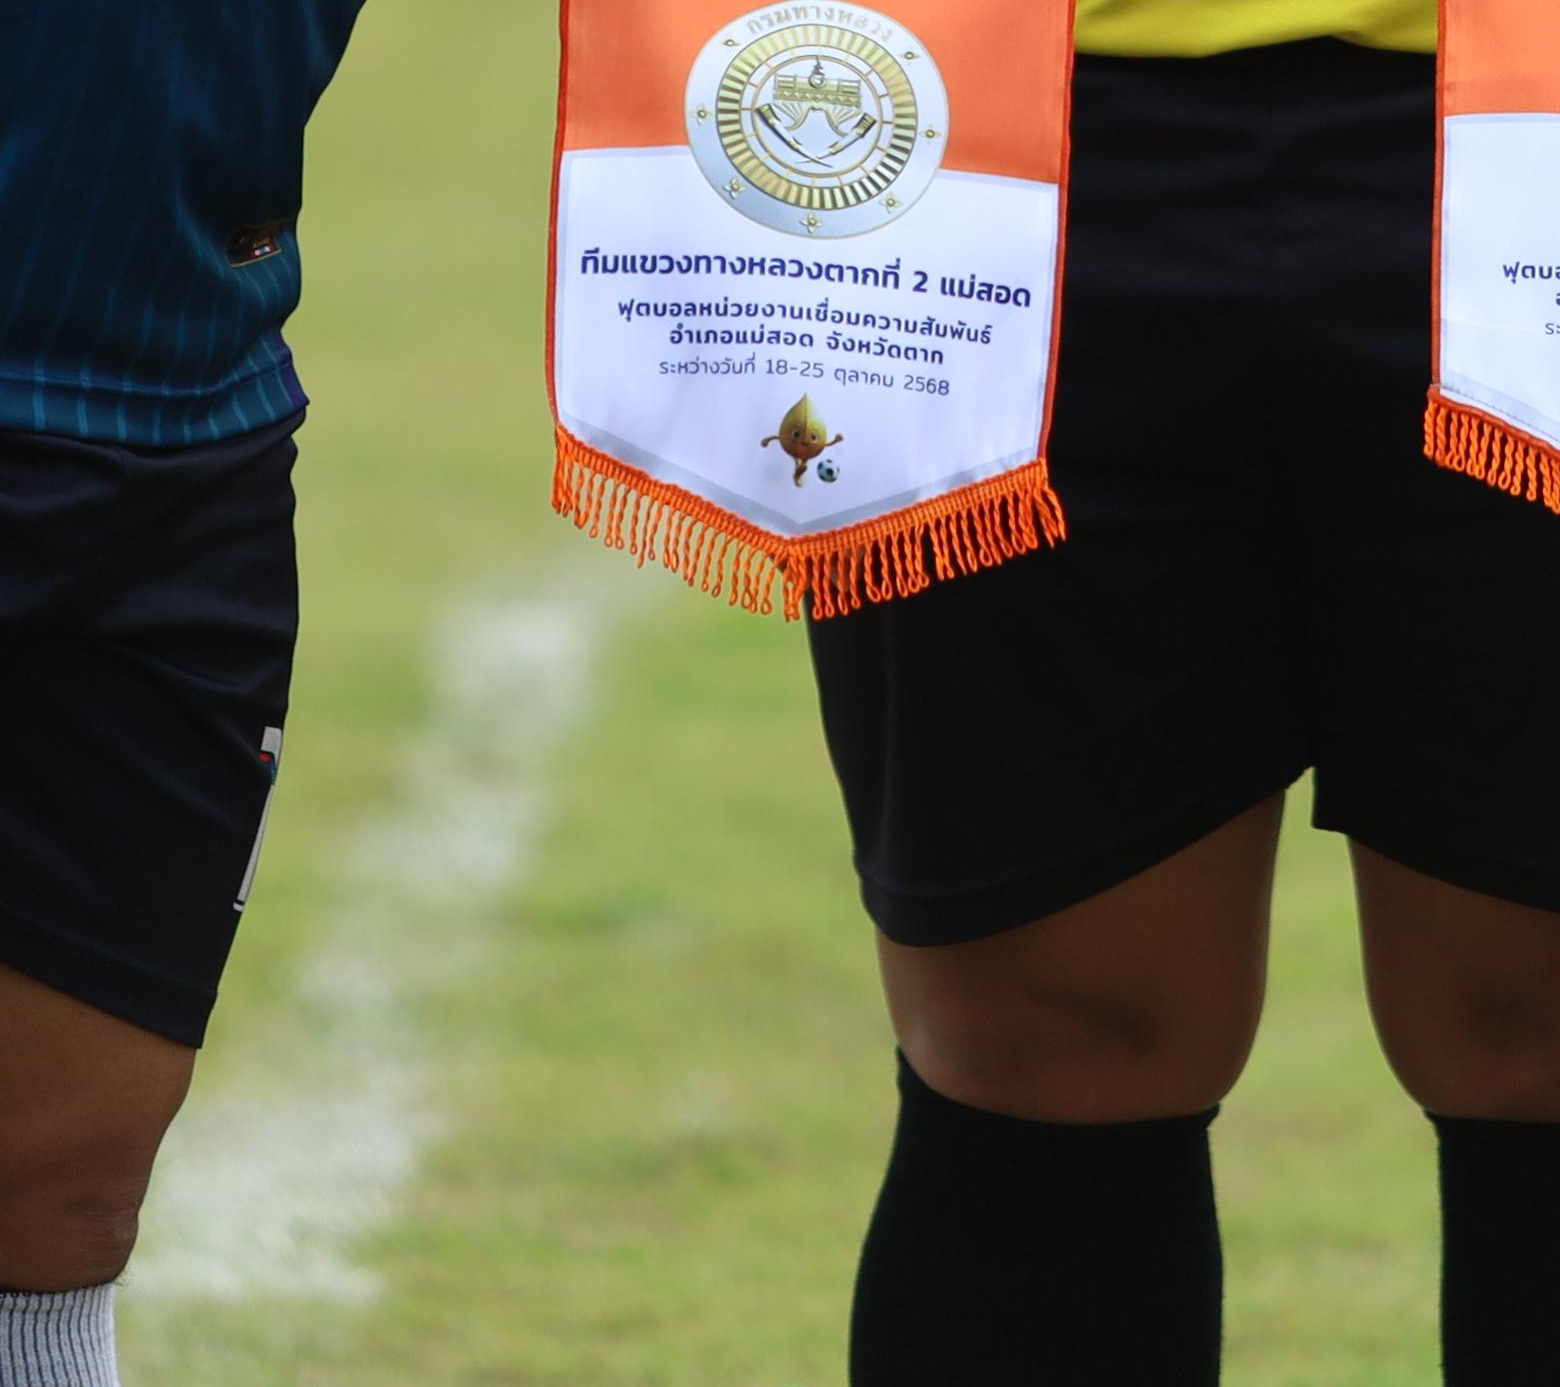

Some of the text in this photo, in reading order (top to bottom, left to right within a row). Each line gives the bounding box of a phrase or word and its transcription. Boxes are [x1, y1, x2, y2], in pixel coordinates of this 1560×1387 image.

[580, 246, 1033, 308] ทีมแขวงทางหลวงตากที่ 2 แม่สอด
[616, 297, 994, 346] ฟุตบอลหน่วยงานเชื่อมความสัมพันธ์
[668, 322, 946, 365] อำเภอแม่สอด จังหวัดตาก
[658, 351, 952, 398] ระหว่างวันที่ 18-25 ตุลาคม 2568
